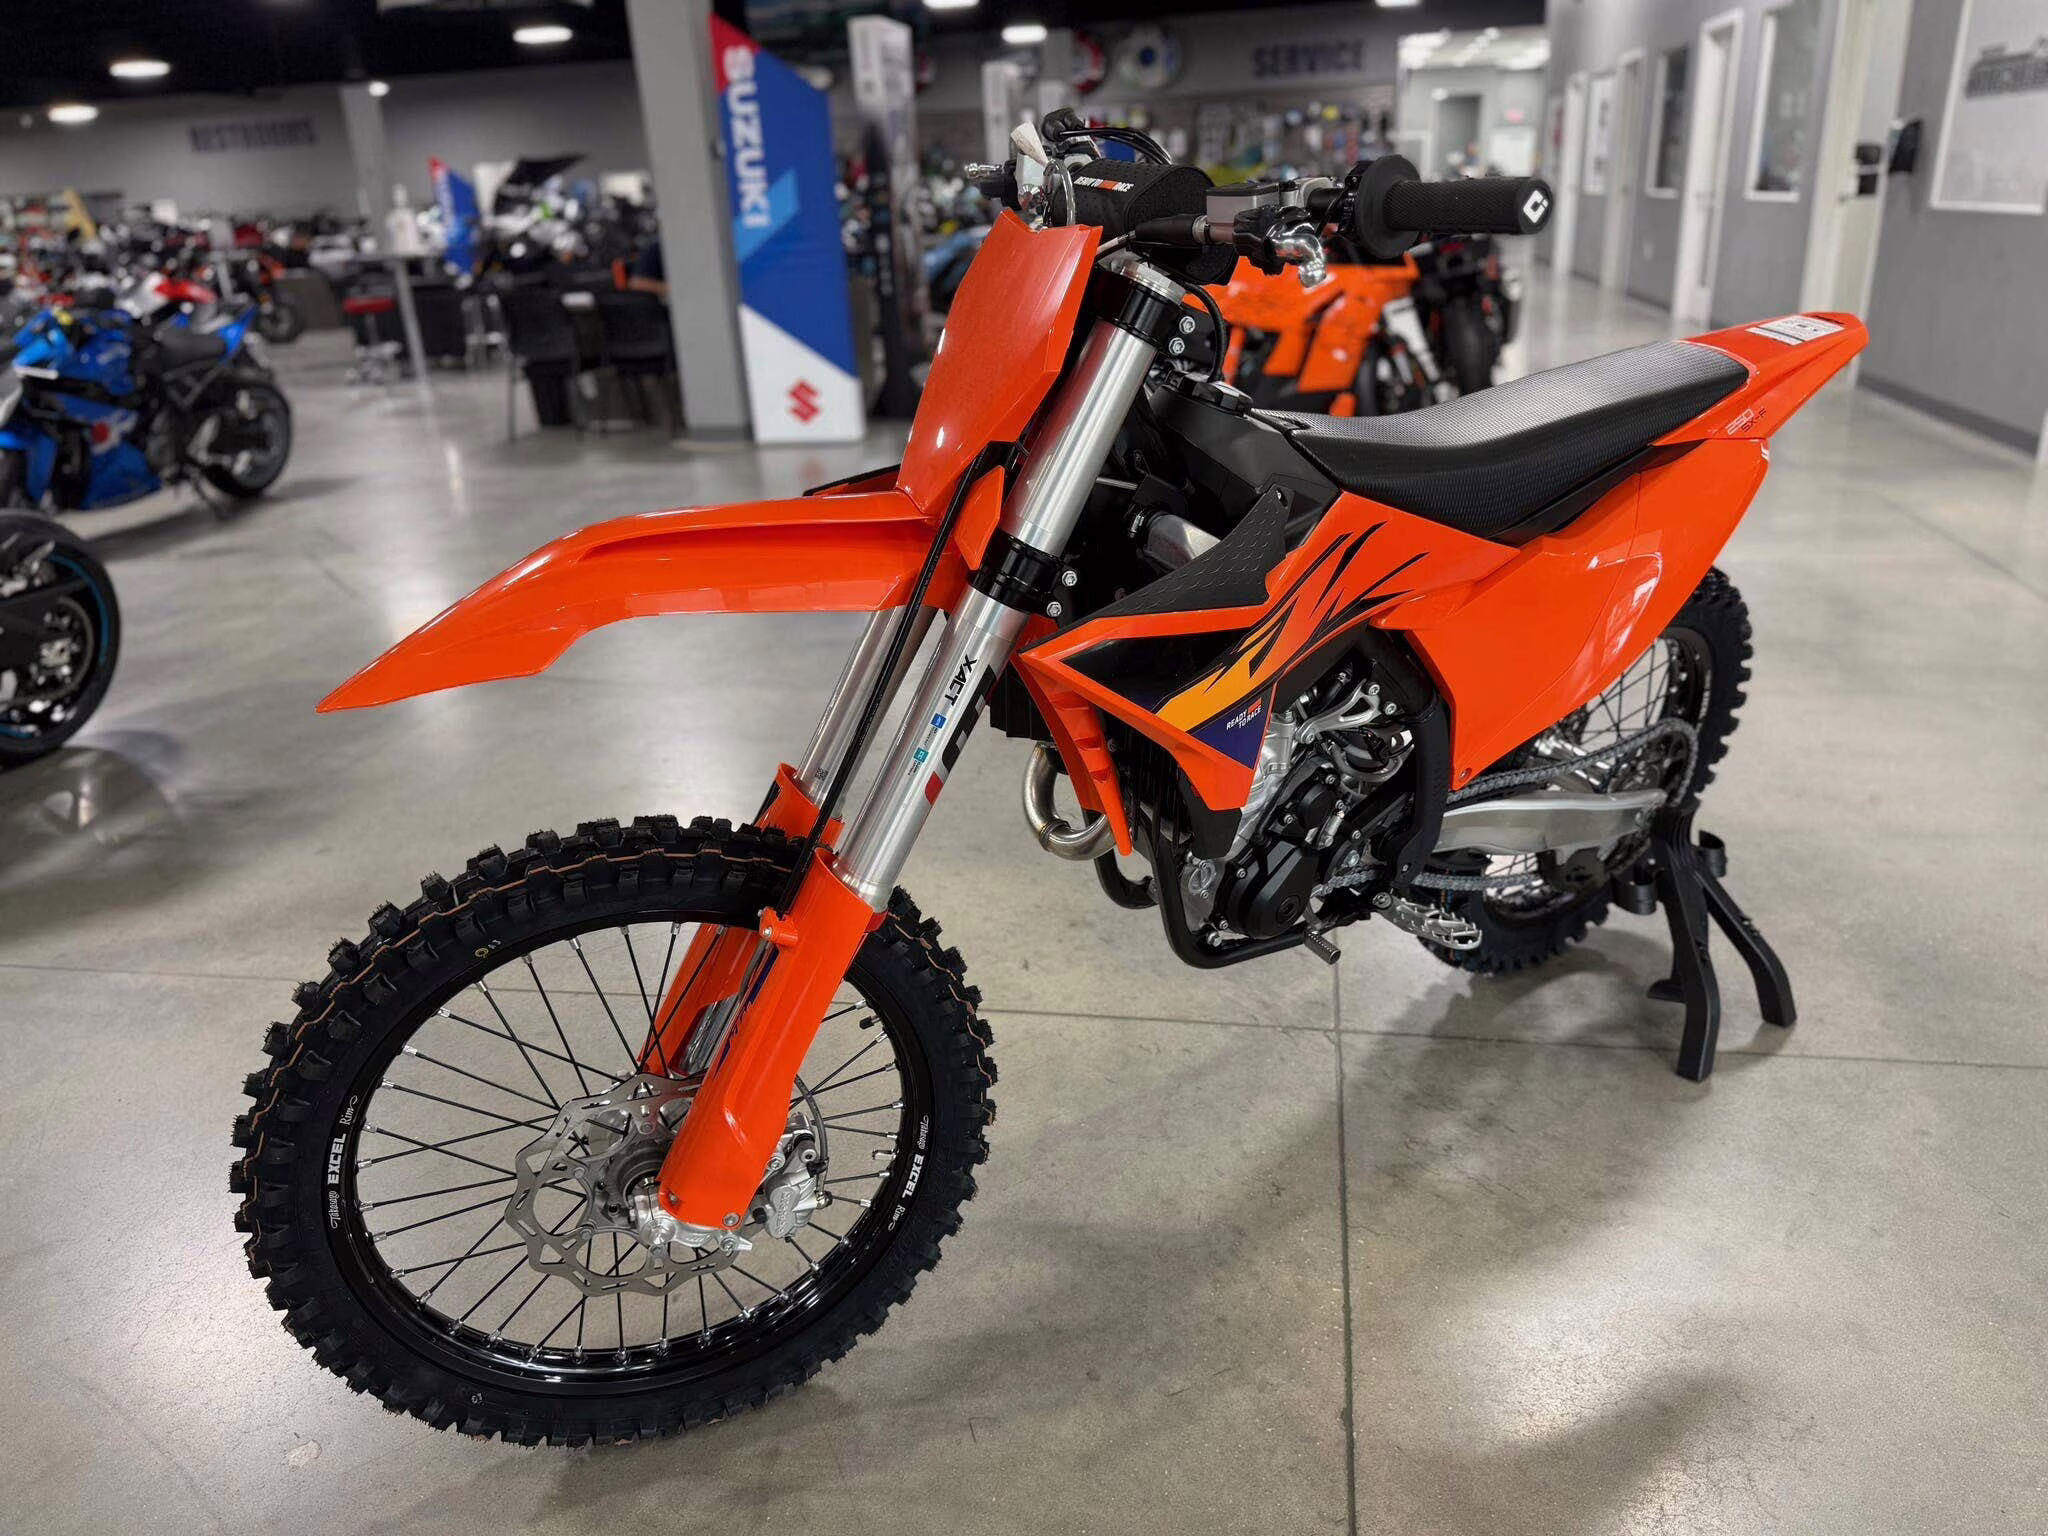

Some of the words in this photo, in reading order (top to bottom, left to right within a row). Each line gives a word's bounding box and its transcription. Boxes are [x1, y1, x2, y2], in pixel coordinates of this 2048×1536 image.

[723, 45, 771, 229] SUZUKI
[1725, 408, 1755, 435] 250
[944, 654, 978, 707] XACT
[1226, 708, 1248, 731] READY
[1246, 704, 1262, 723] RACE
[339, 1094, 358, 1126] Rim
[327, 1133, 347, 1185] EXCEL
[901, 1153, 925, 1198] EXCEL
[327, 1190, 342, 1229] Takasago
[887, 1204, 906, 1231] Rim
